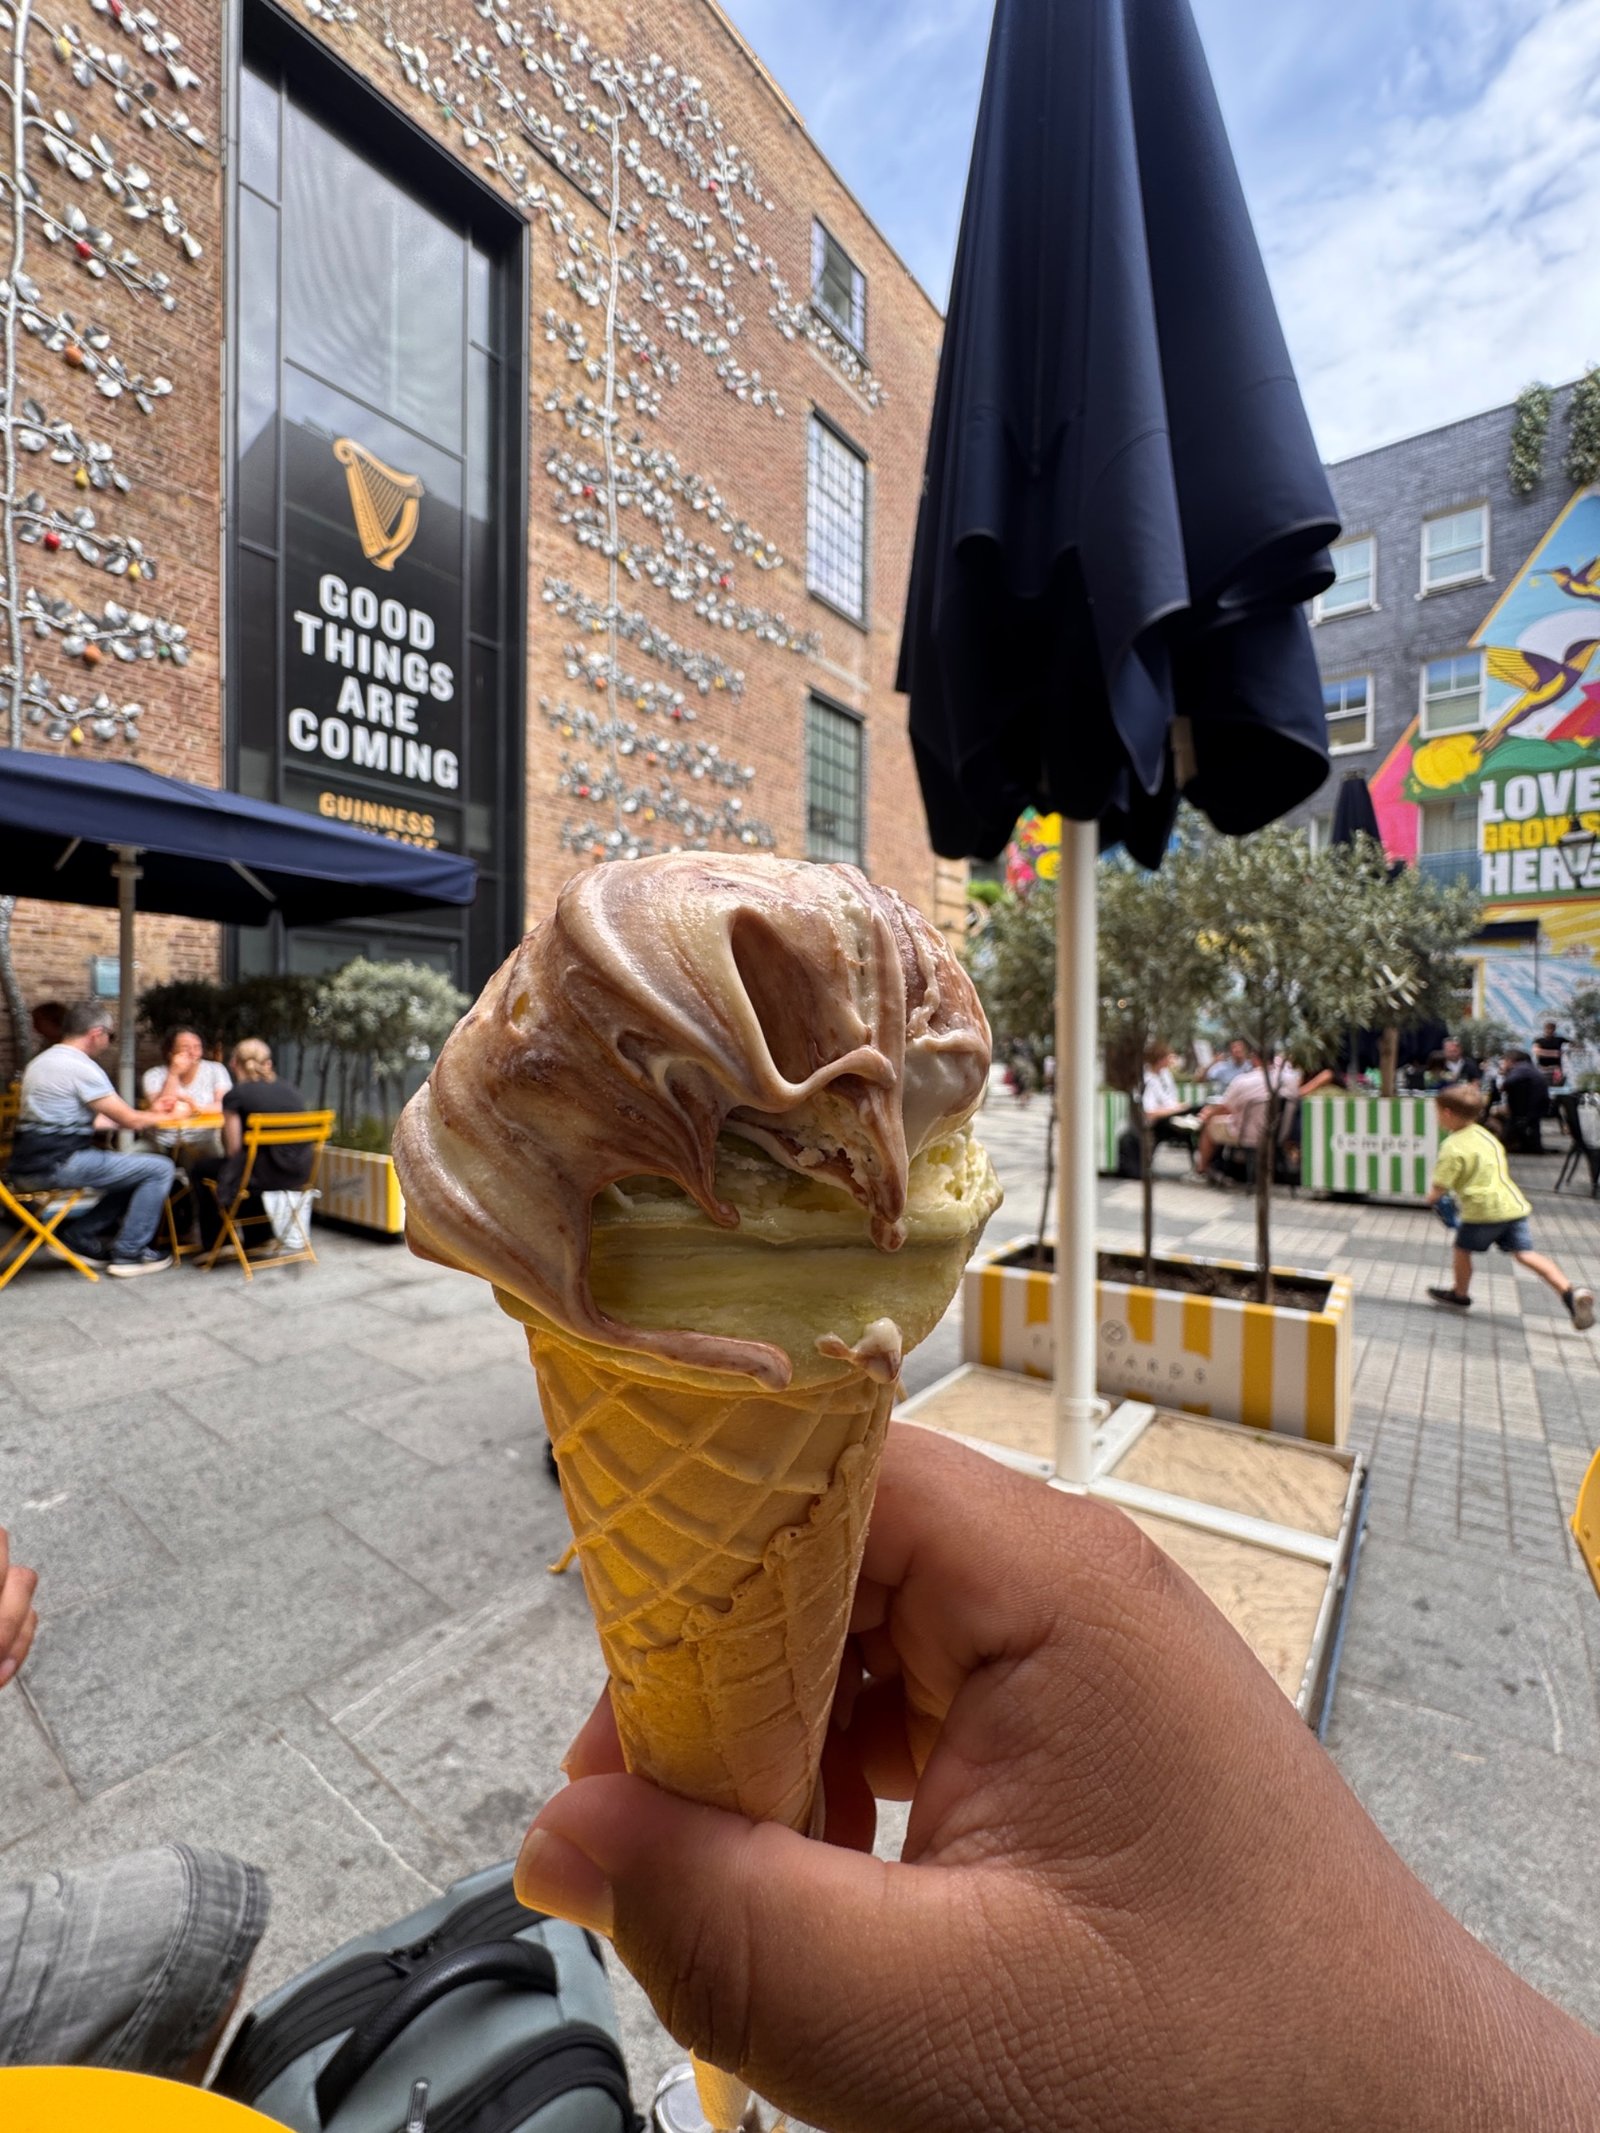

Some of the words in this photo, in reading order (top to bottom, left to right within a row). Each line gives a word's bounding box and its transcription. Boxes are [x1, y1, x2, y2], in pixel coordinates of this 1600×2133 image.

[319, 573, 435, 651] GOOD
[294, 610, 454, 701] THINGS
[336, 675, 418, 735] ARE
[288, 708, 459, 790] COMING
[319, 791, 435, 838] GUINNESS
[1480, 767, 1600, 823] LOVE
